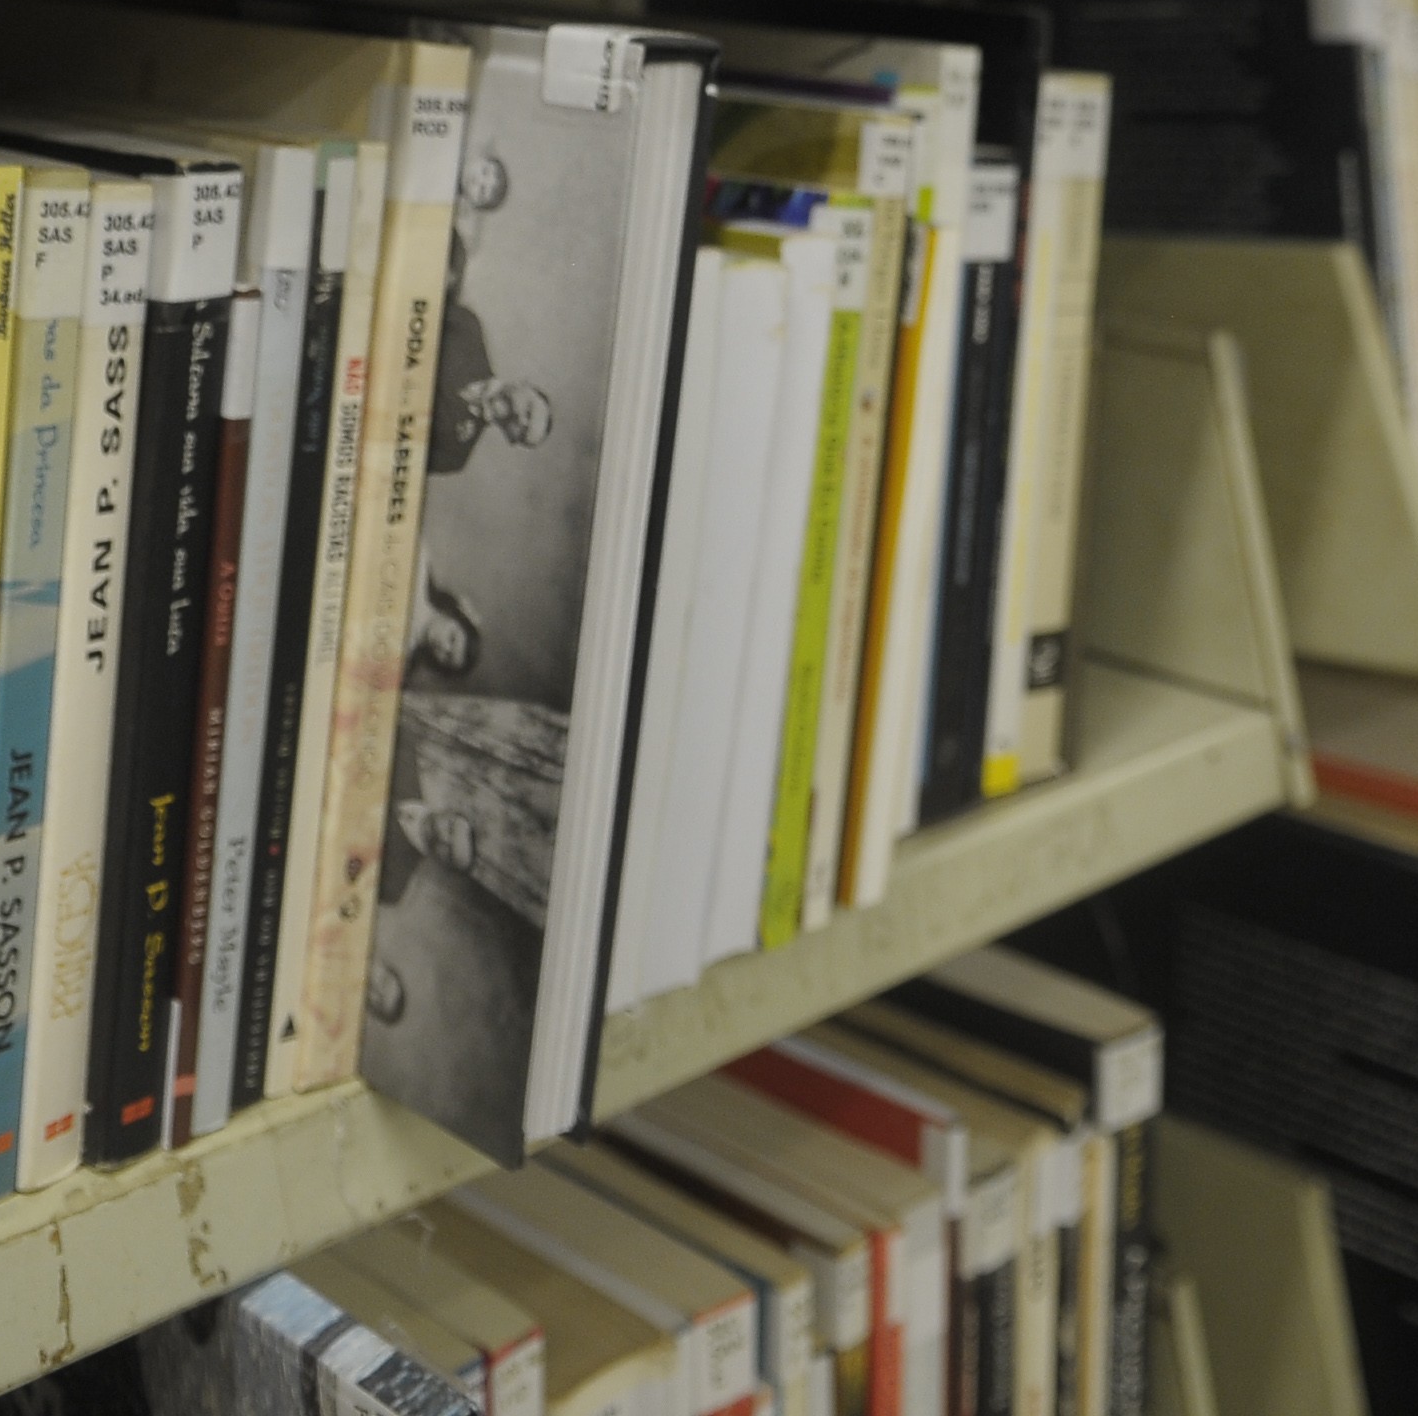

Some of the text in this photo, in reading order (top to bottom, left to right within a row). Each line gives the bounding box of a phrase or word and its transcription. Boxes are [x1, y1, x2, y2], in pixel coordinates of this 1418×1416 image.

[37, 224, 74, 246] SAS
[191, 207, 225, 226] SAS
[102, 237, 139, 259] SAS
[403, 298, 430, 372] RODA
[385, 414, 418, 526] SABERES
[84, 477, 119, 676] JEAN P.
[4, 748, 35, 844] JEAN
[1, 854, 27, 887] P.
